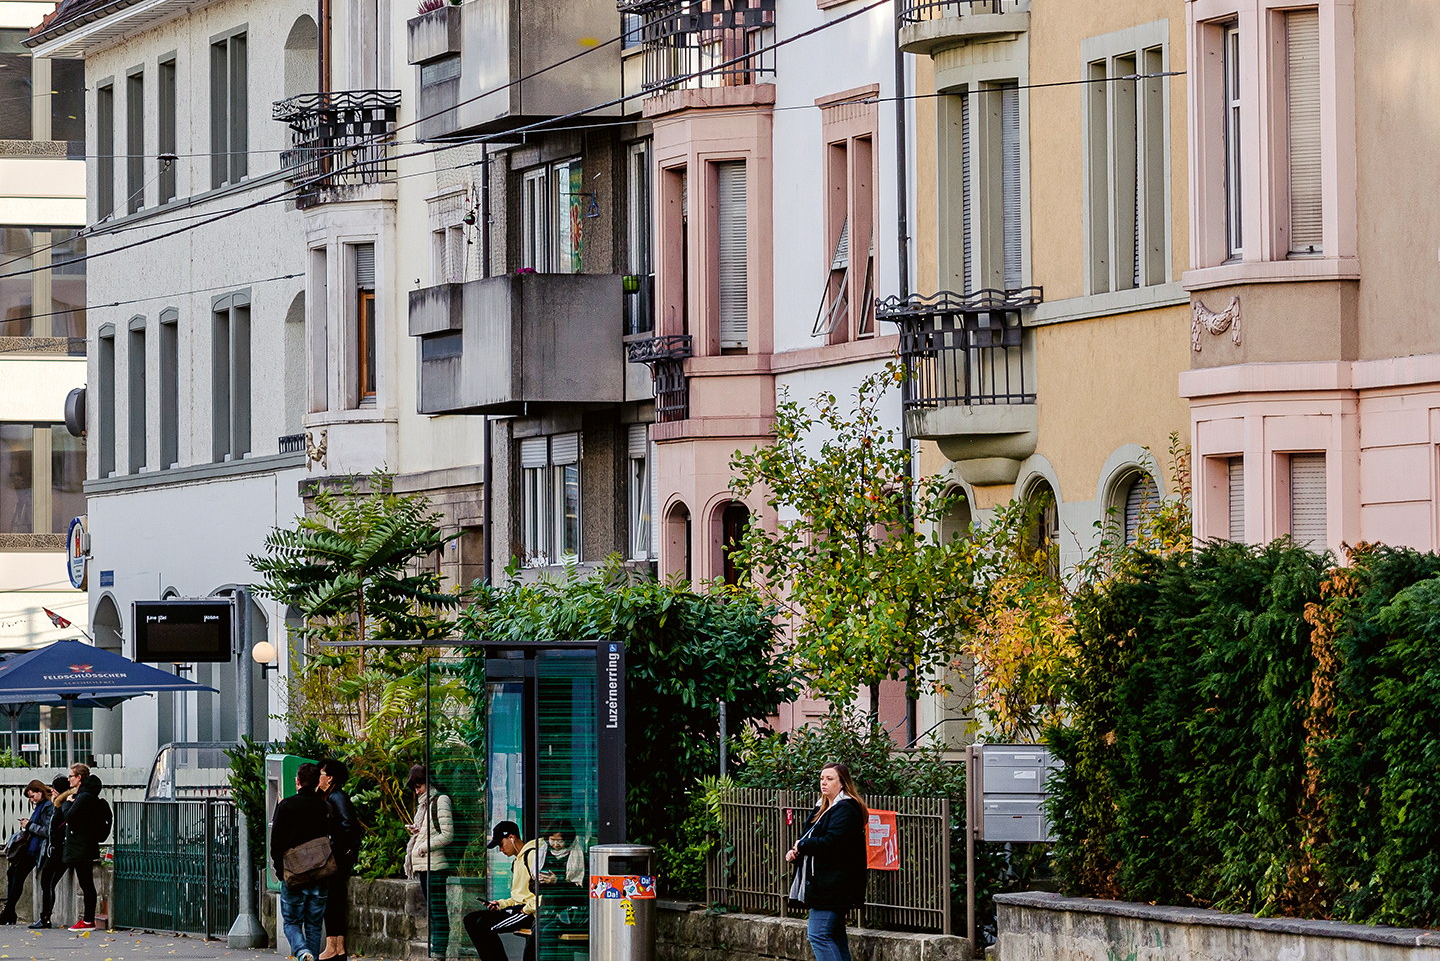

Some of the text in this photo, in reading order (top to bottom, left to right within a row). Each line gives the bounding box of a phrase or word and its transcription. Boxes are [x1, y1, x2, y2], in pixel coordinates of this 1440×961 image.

[43, 672, 128, 681] FELDSCHLÖSSCHEN
[605, 653, 620, 729] Luzernerring
[641, 877, 651, 885] Da!
[606, 890, 619, 898] Da!
